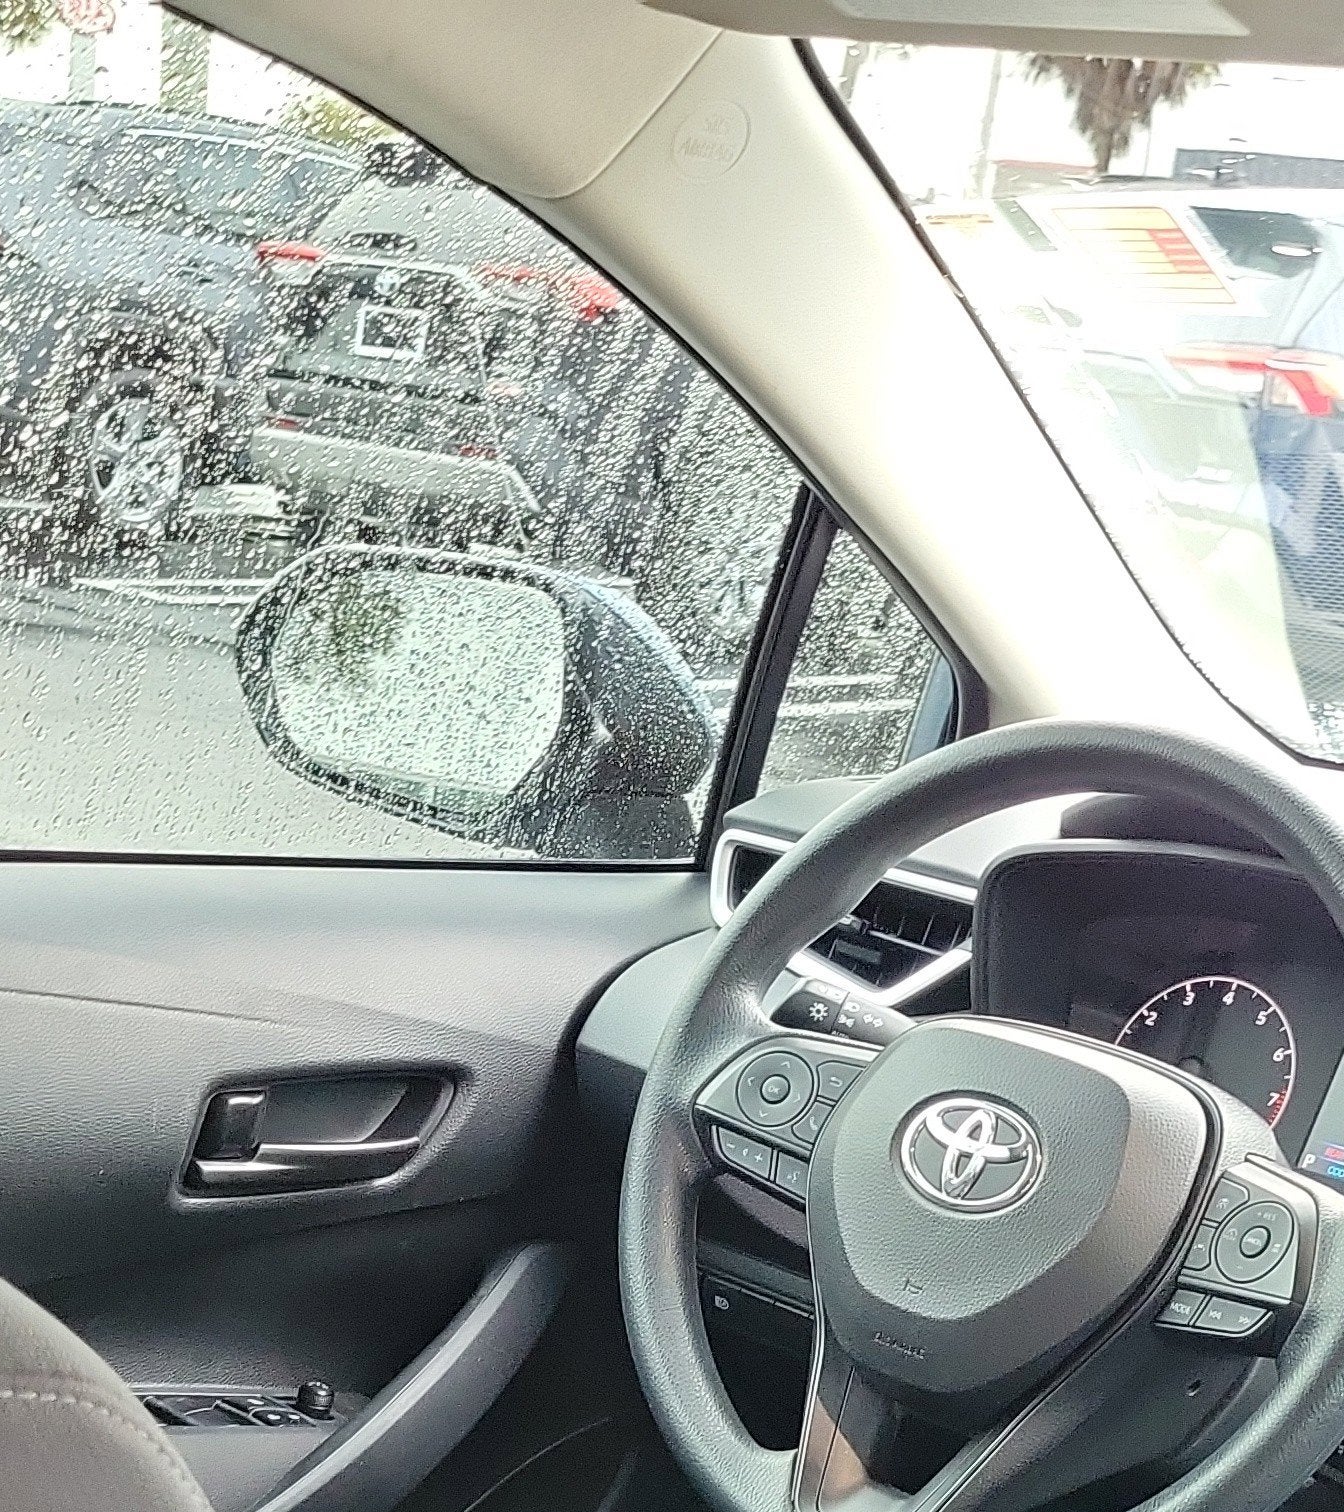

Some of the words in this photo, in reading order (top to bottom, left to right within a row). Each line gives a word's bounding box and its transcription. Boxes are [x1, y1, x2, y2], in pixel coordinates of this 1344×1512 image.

[1183, 991, 1195, 1006] 3
[1222, 992, 1235, 1005] 4
[1145, 1012, 1158, 1026] 2
[1255, 1012, 1268, 1025] 5
[1272, 1048, 1284, 1061] 6
[1266, 1092, 1279, 1106] 7
[1302, 1153, 1315, 1168] P
[1169, 1300, 1192, 1315] MODE
